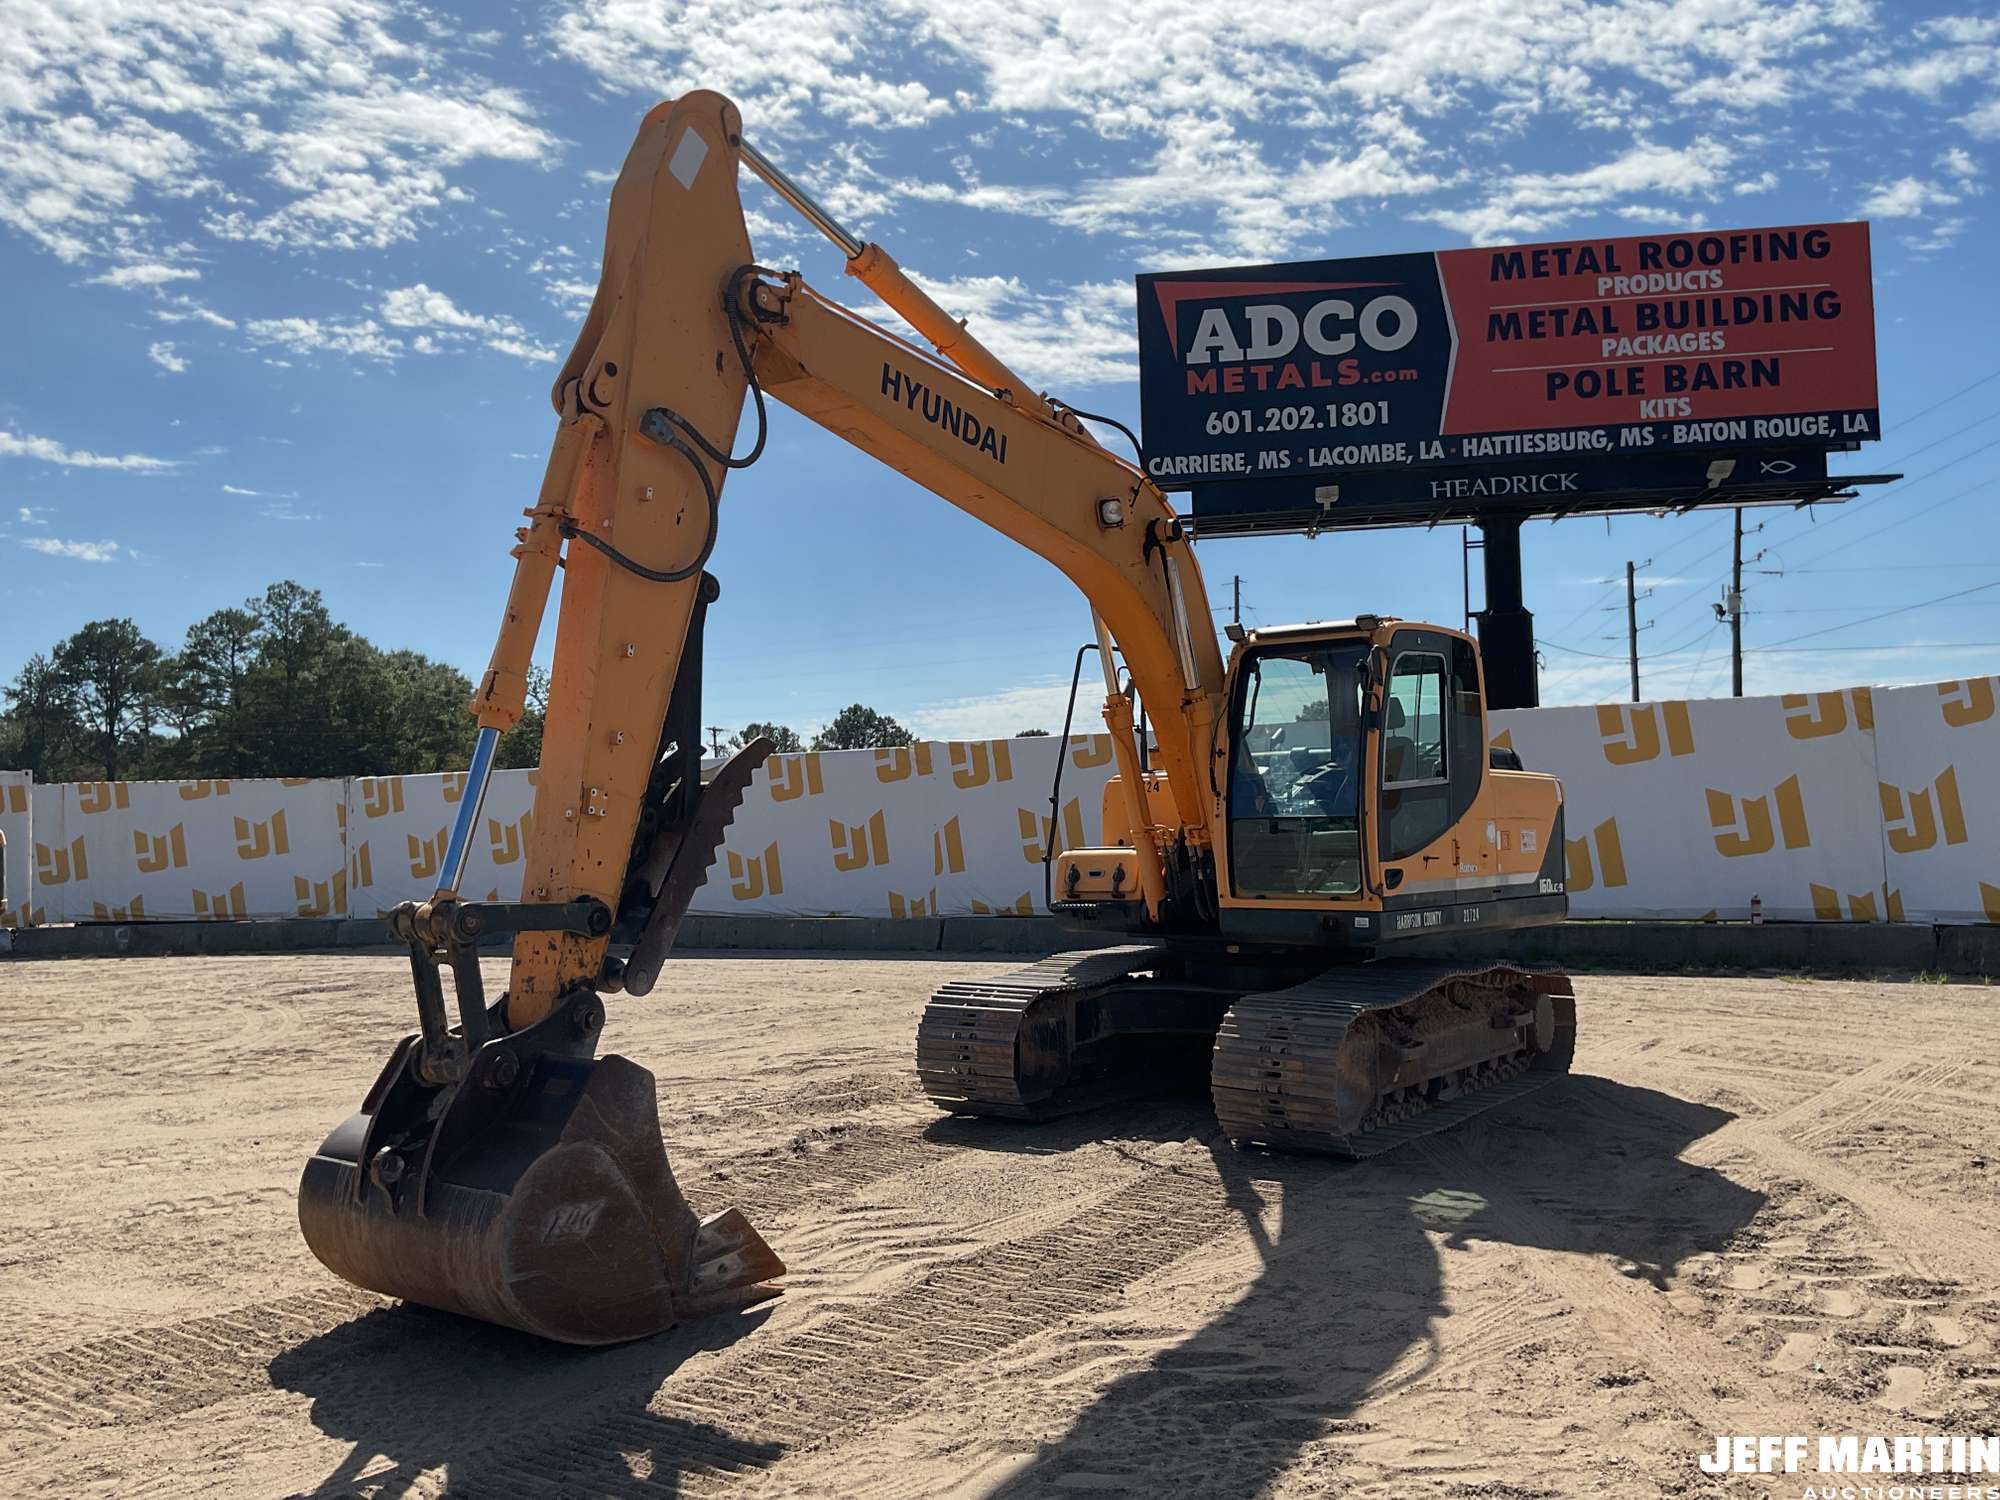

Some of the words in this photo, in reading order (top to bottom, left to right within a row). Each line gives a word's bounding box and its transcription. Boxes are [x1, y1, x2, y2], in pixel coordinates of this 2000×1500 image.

[1490, 244, 1622, 282] METAL
[1639, 229, 1831, 270] ROOFING
[1598, 269, 1724, 297] PRODUCTS
[1186, 295, 1418, 364] ADCO
[1487, 305, 1619, 342] METAL
[1636, 290, 1842, 332] BUILDING
[1602, 331, 1726, 358] PACKAGES
[1546, 367, 1646, 401] POLE
[1663, 358, 1781, 393] BARN
[880, 362, 1008, 464] HYUNDAI
[1205, 401, 1389, 436] 601.202.1801
[1639, 397, 1692, 420] KITS
[1149, 453, 1252, 476] CARRIERE,
[1258, 450, 1291, 470] MS
[1308, 442, 1413, 467] LACOMBE,
[1419, 440, 1445, 460] LA
[1462, 431, 1614, 458] HATTIESBURG,
[1620, 426, 1655, 448] MS
[1673, 421, 1747, 444] BATON
[1753, 416, 1836, 438] ROUGE,
[1842, 413, 1870, 434] LA
[1429, 472, 1580, 499] HEADRICK
